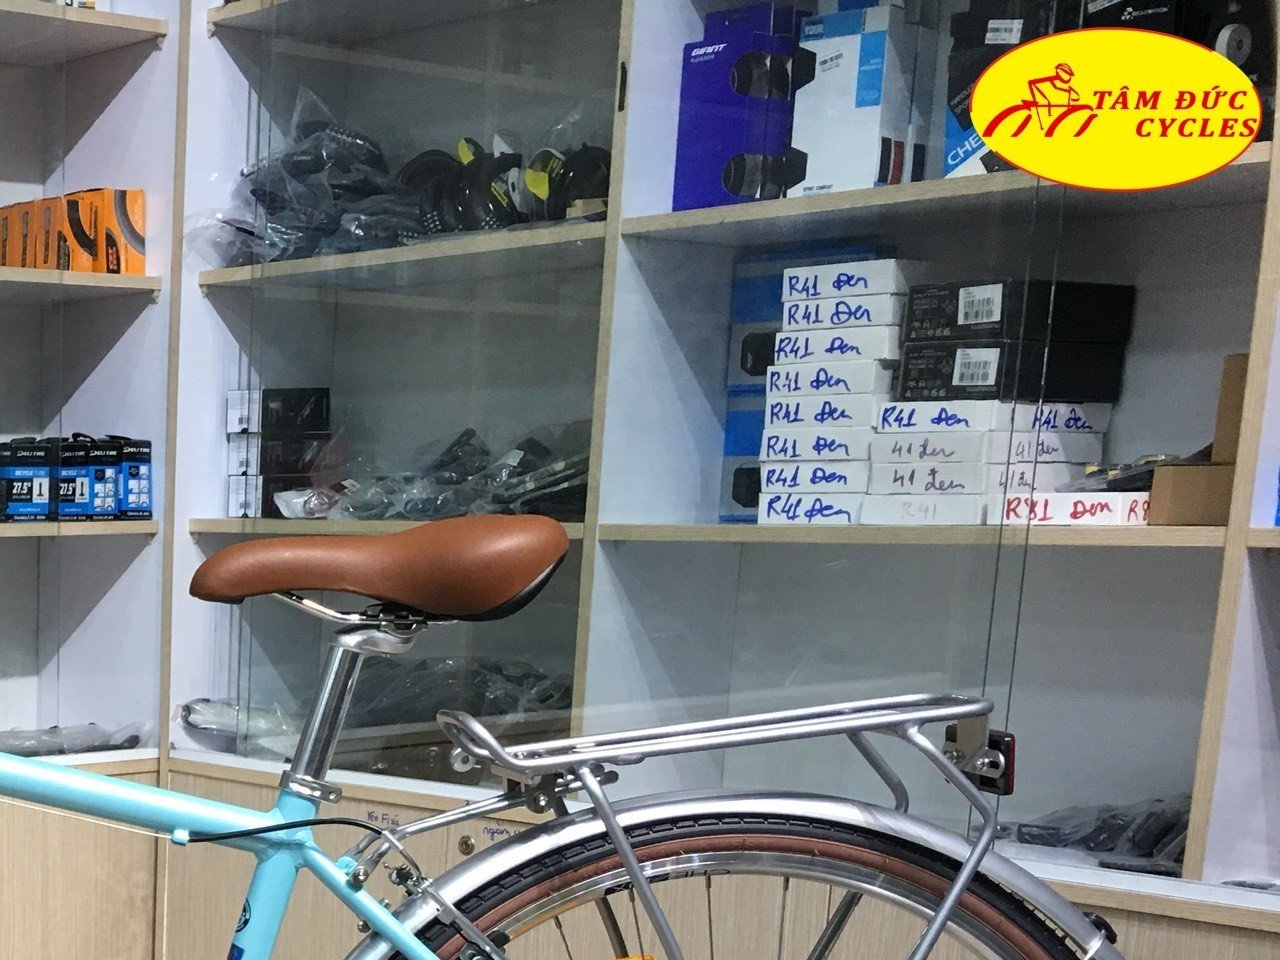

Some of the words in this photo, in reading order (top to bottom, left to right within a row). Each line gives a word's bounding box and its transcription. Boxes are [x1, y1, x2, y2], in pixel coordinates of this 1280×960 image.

[690, 43, 728, 57] GIANT
[788, 275, 821, 297] R41
[787, 303, 823, 325] R41
[775, 336, 814, 361] R41
[770, 370, 801, 392] R41
[770, 402, 804, 424] R41
[882, 405, 917, 430] R41
[767, 435, 801, 458] R41
[766, 465, 800, 487] R41
[767, 493, 802, 521] R41
